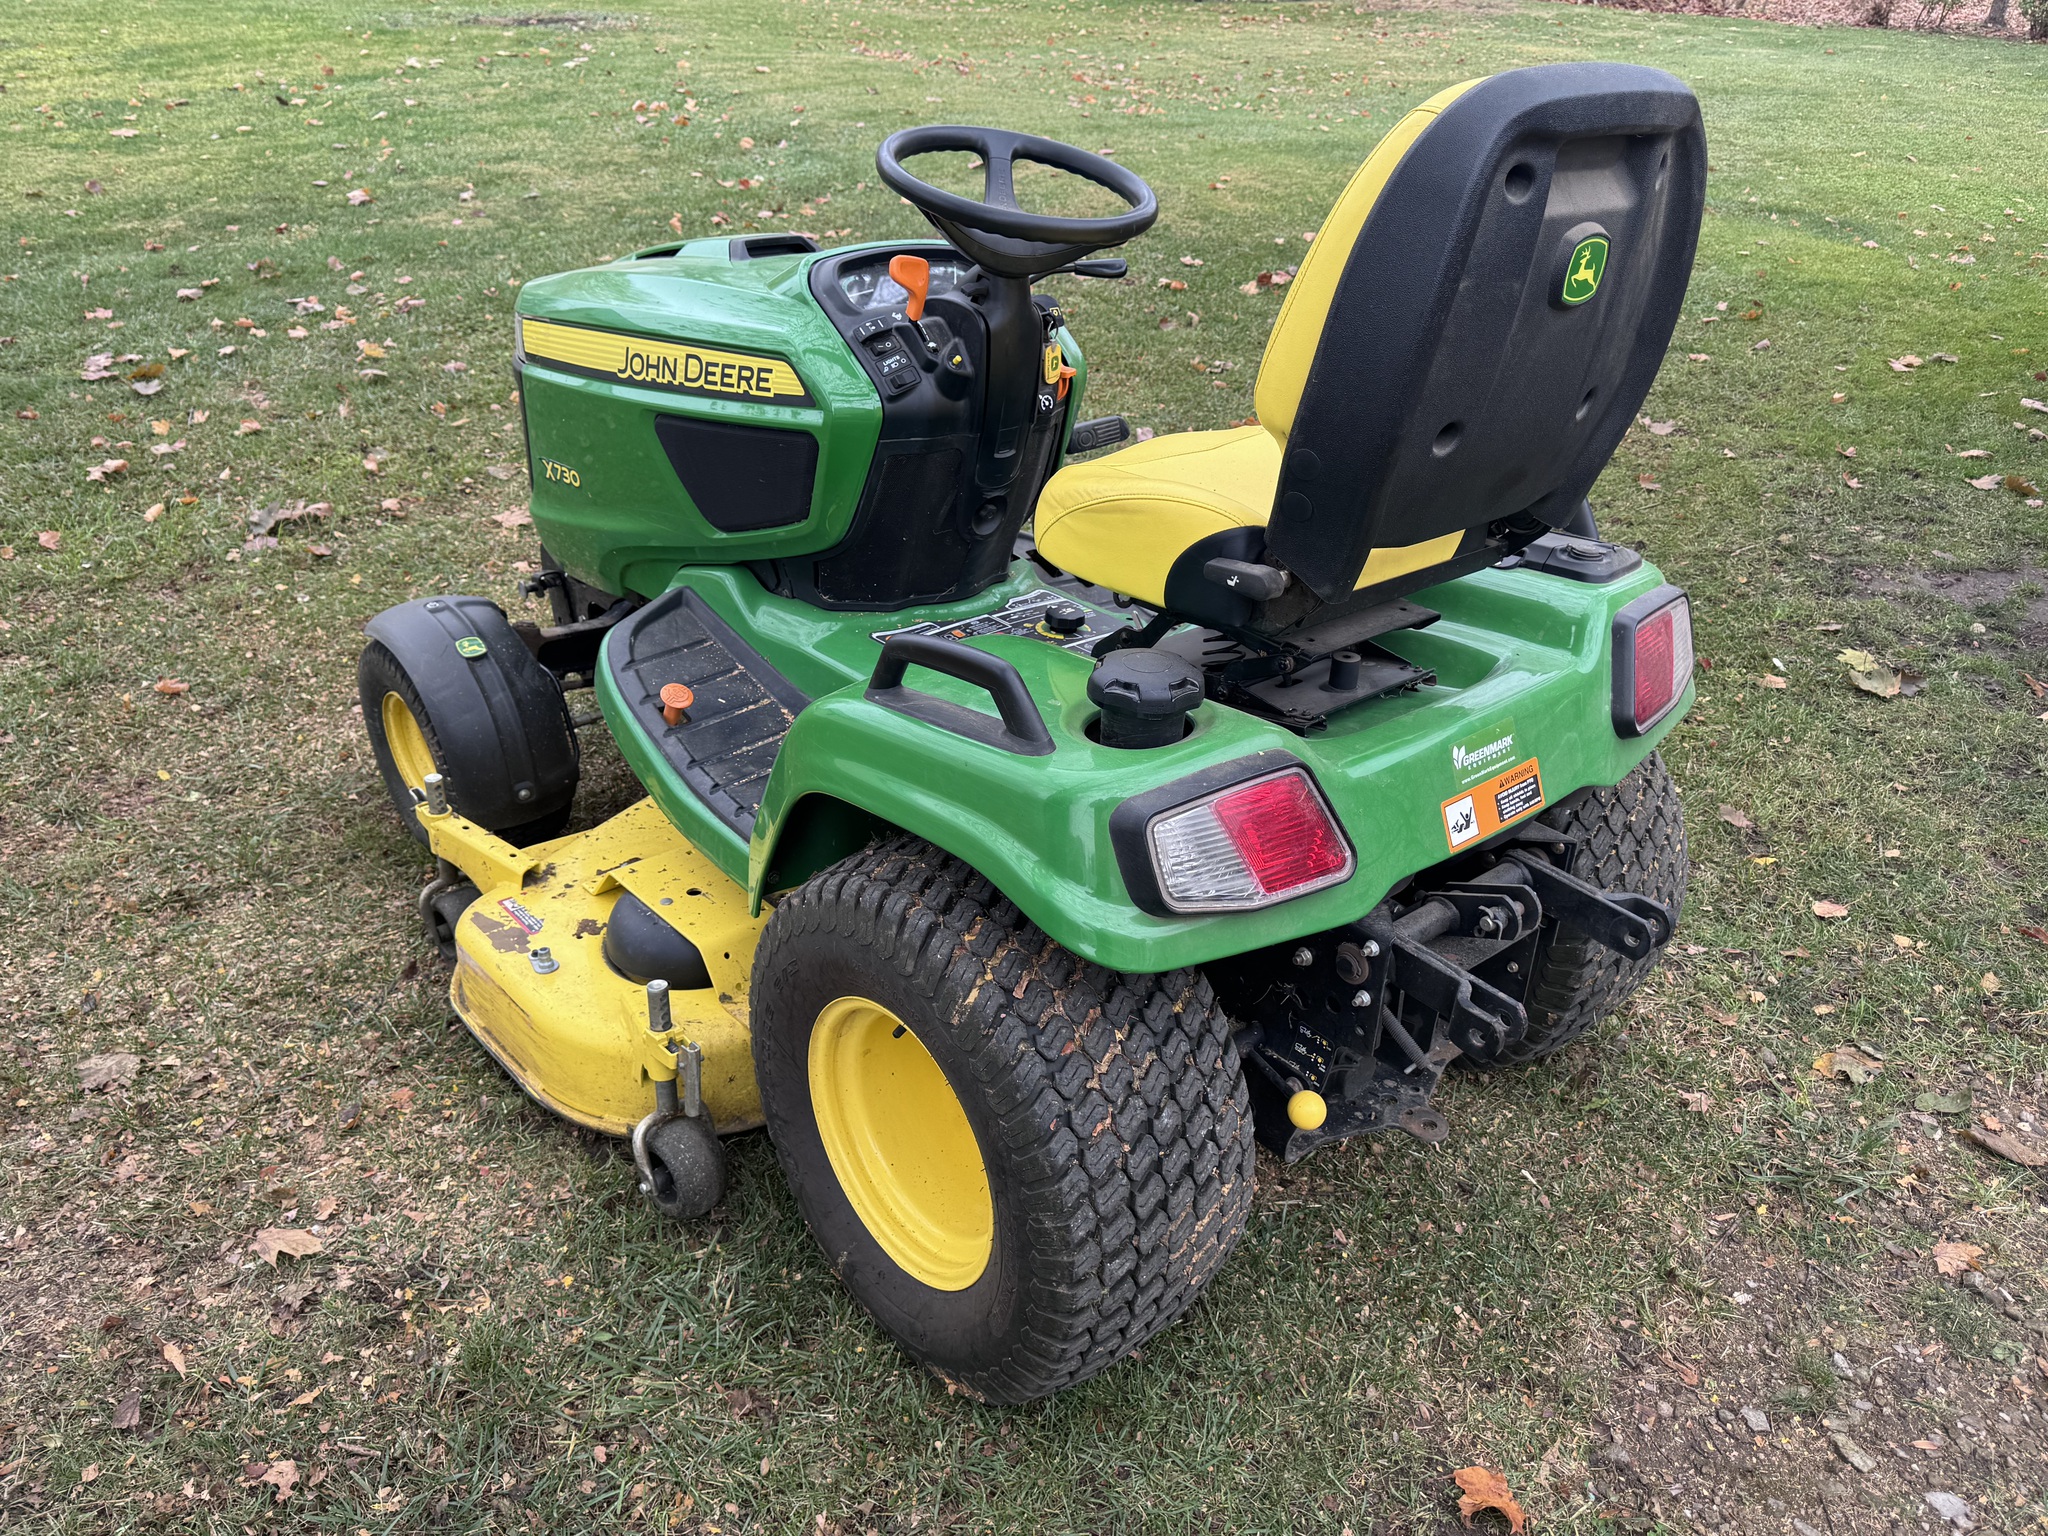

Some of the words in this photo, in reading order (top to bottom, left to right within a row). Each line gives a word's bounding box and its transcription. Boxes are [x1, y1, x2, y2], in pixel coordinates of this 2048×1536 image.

[617, 346, 678, 383] JOHN
[683, 353, 774, 393] DEERE
[883, 355, 900, 366] LIGHTS
[541, 458, 581, 488] X730
[1463, 735, 1513, 766] GREENMARK
[1468, 747, 1511, 770] EQUIPMENT
[1504, 764, 1534, 786] WARNING
